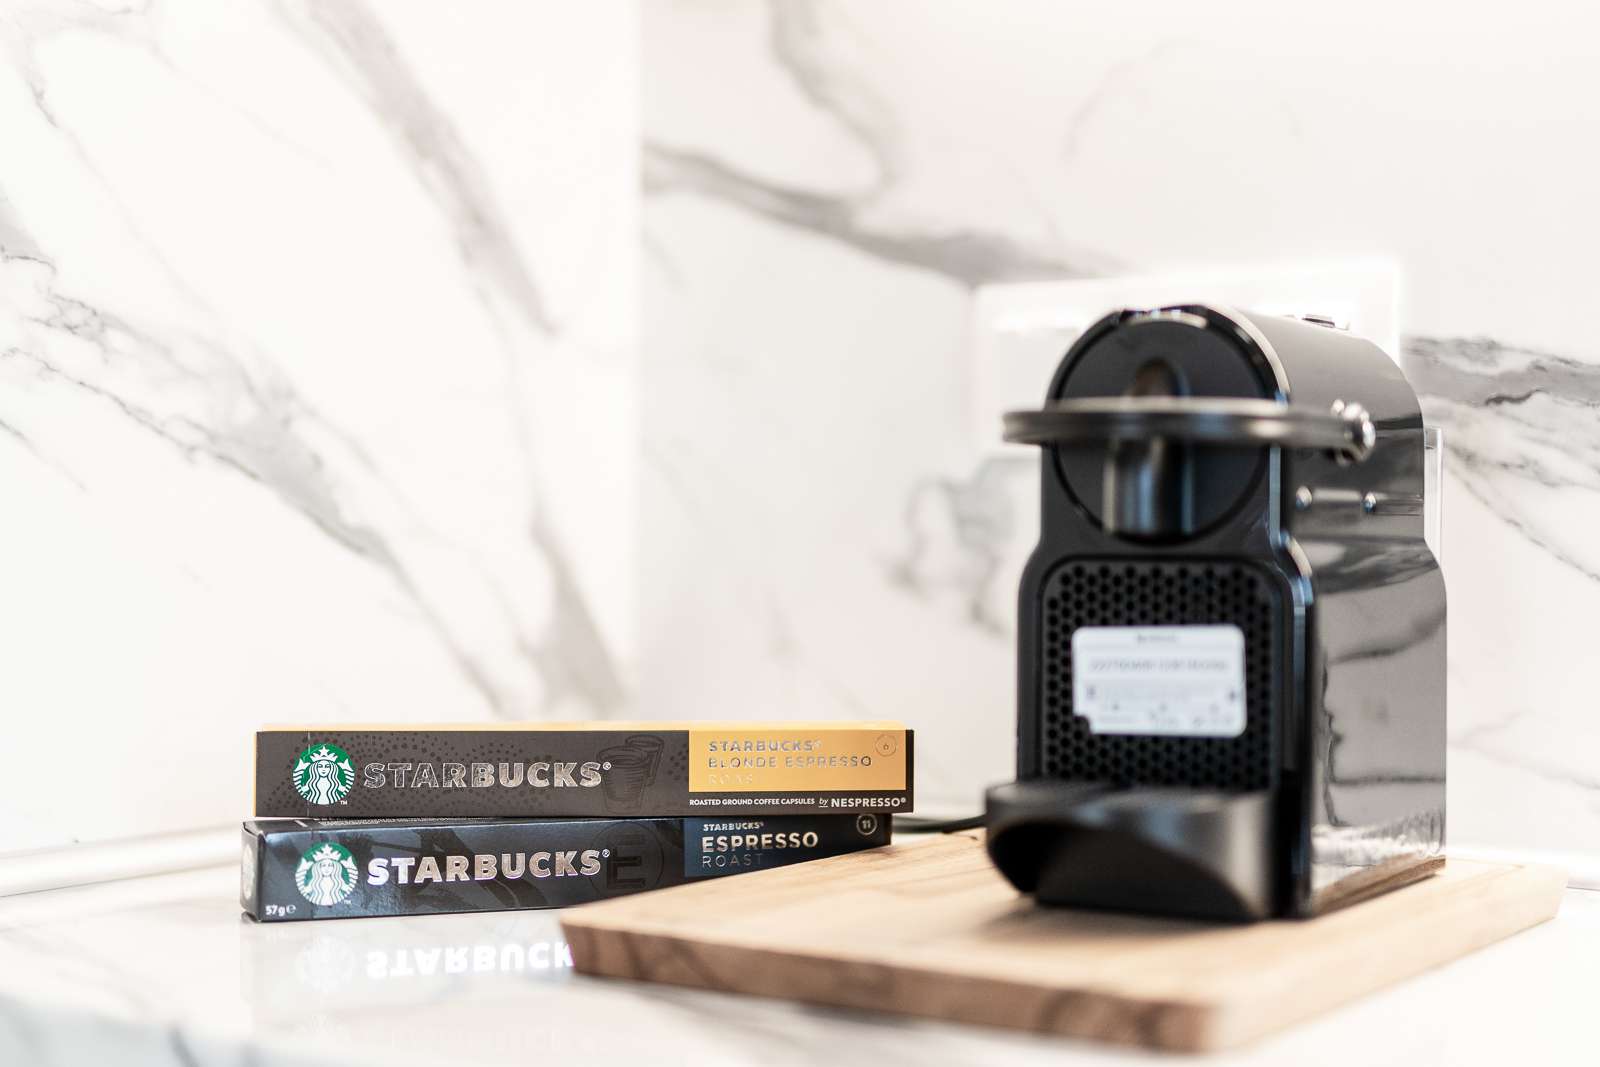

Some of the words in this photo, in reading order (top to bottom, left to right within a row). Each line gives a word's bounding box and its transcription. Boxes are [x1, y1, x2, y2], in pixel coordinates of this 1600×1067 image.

[708, 756, 777, 768] BLONDE
[785, 755, 872, 768] ESPRESSO
[722, 798, 753, 806] GROUND
[818, 797, 828, 807] by
[702, 831, 819, 853] ESPRESSO
[702, 853, 764, 868] ROAST
